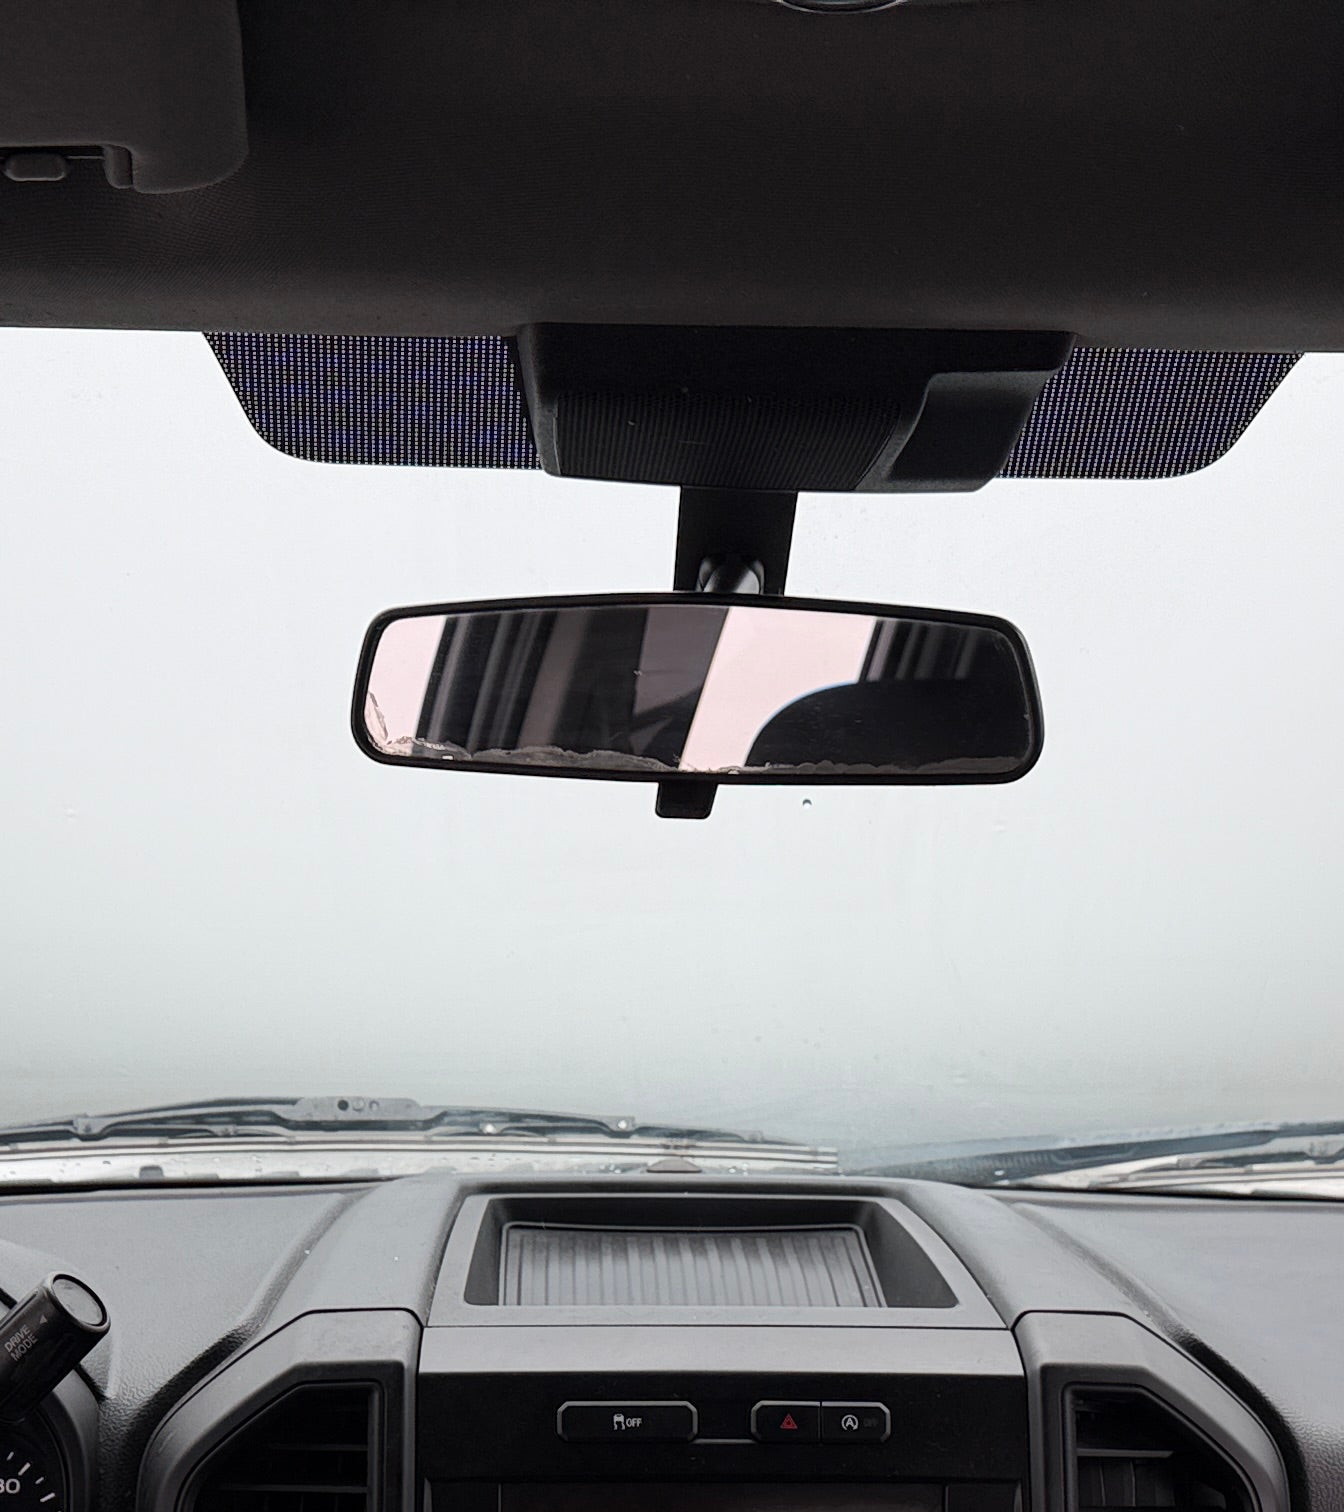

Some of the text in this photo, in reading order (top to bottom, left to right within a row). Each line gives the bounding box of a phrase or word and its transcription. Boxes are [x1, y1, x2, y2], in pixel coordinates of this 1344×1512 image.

[4, 1324, 32, 1352] DRIVE
[10, 1334, 38, 1362] MODE
[625, 1417, 642, 1428] OFF
